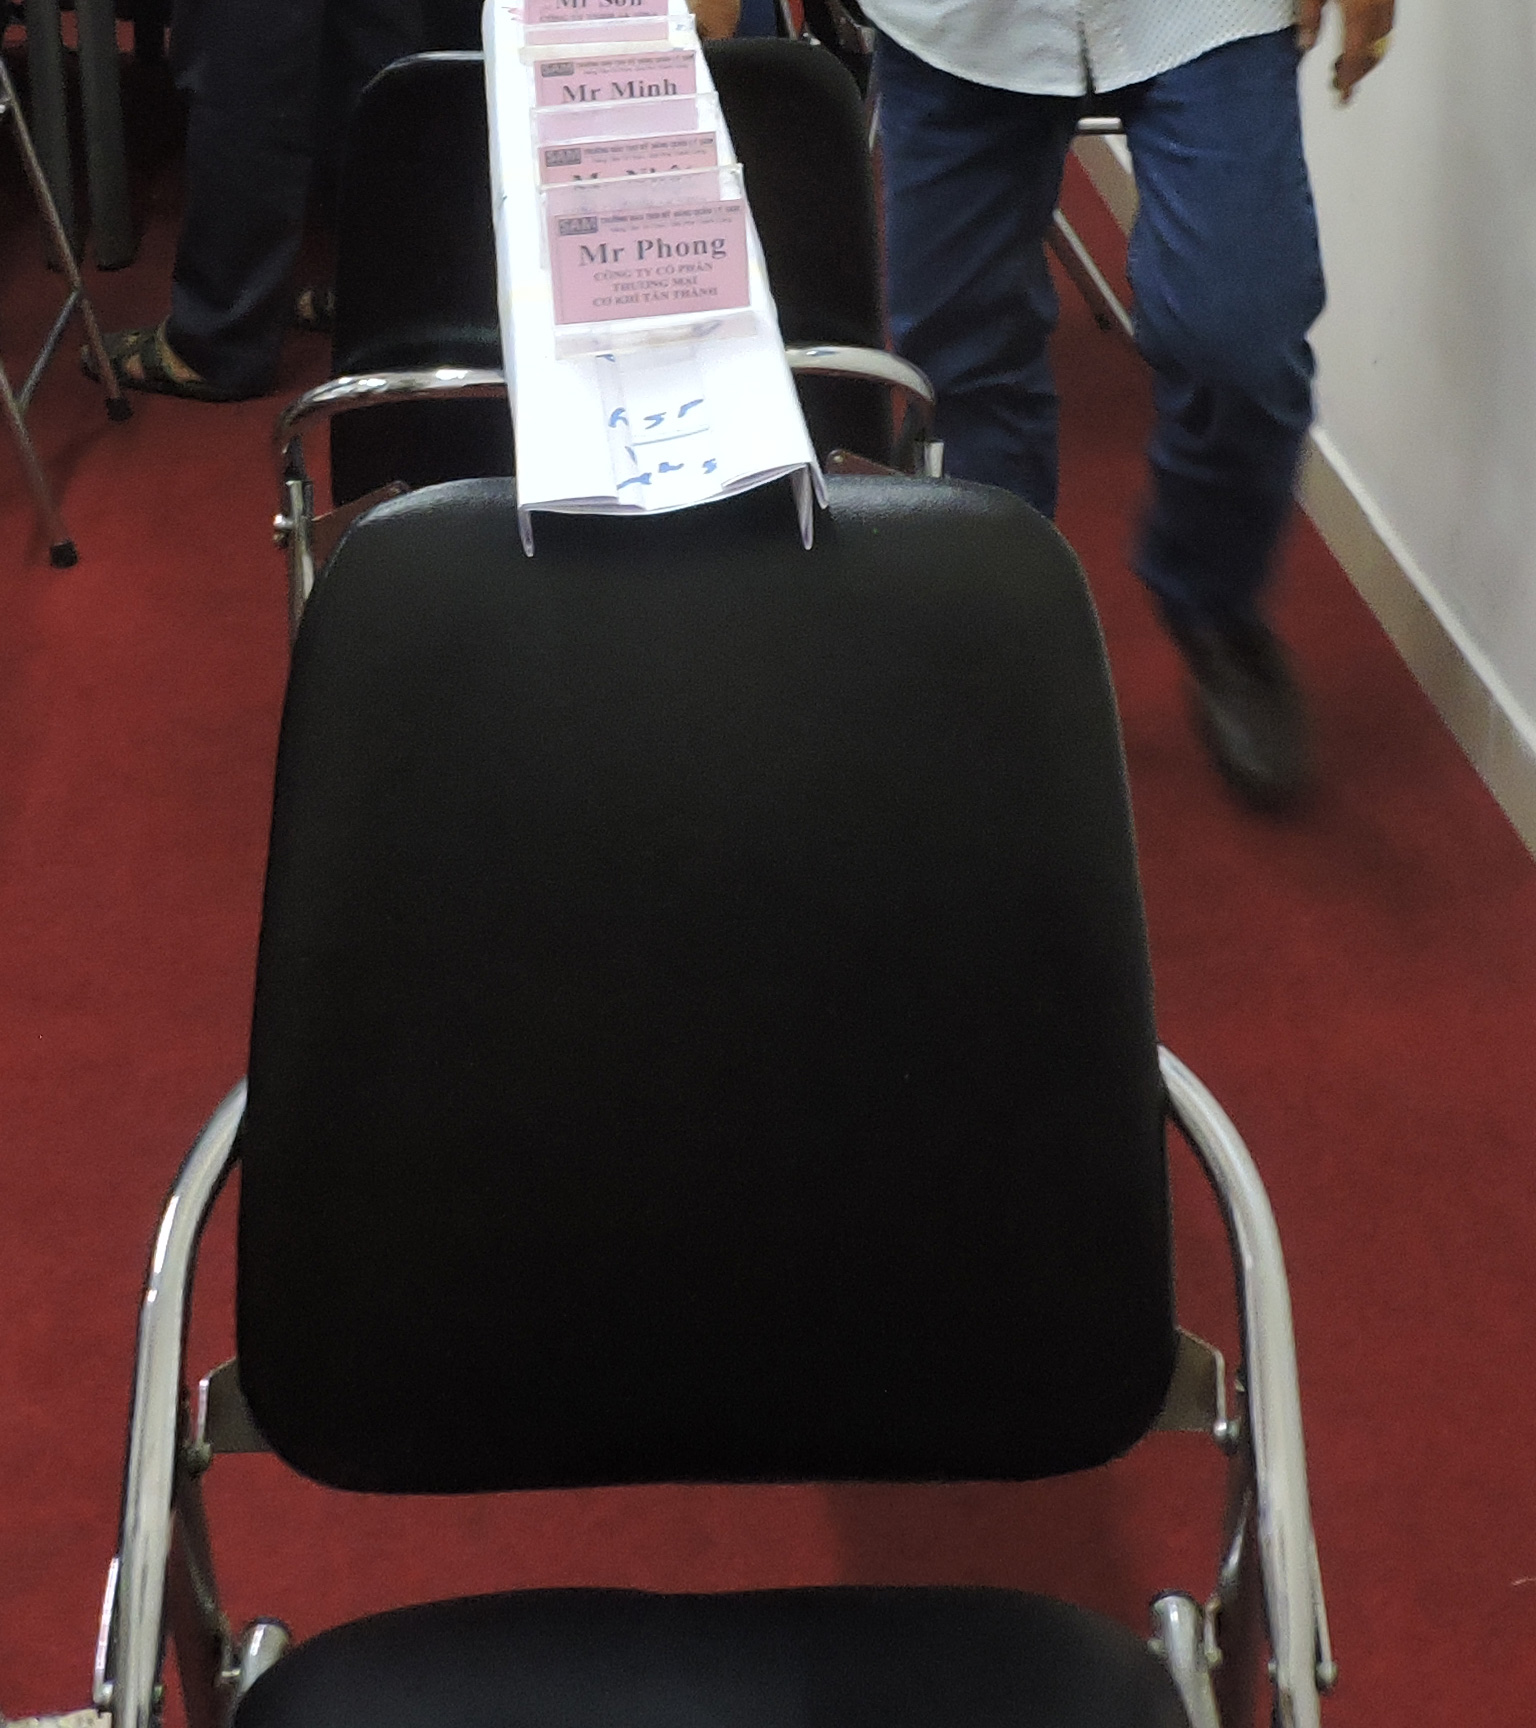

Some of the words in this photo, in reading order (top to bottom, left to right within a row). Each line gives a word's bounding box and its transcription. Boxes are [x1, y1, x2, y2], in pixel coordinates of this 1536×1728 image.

[561, 83, 602, 104] Mr
[610, 78, 678, 100] Minh
[578, 242, 625, 267] Mr
[635, 237, 728, 261] Phong
